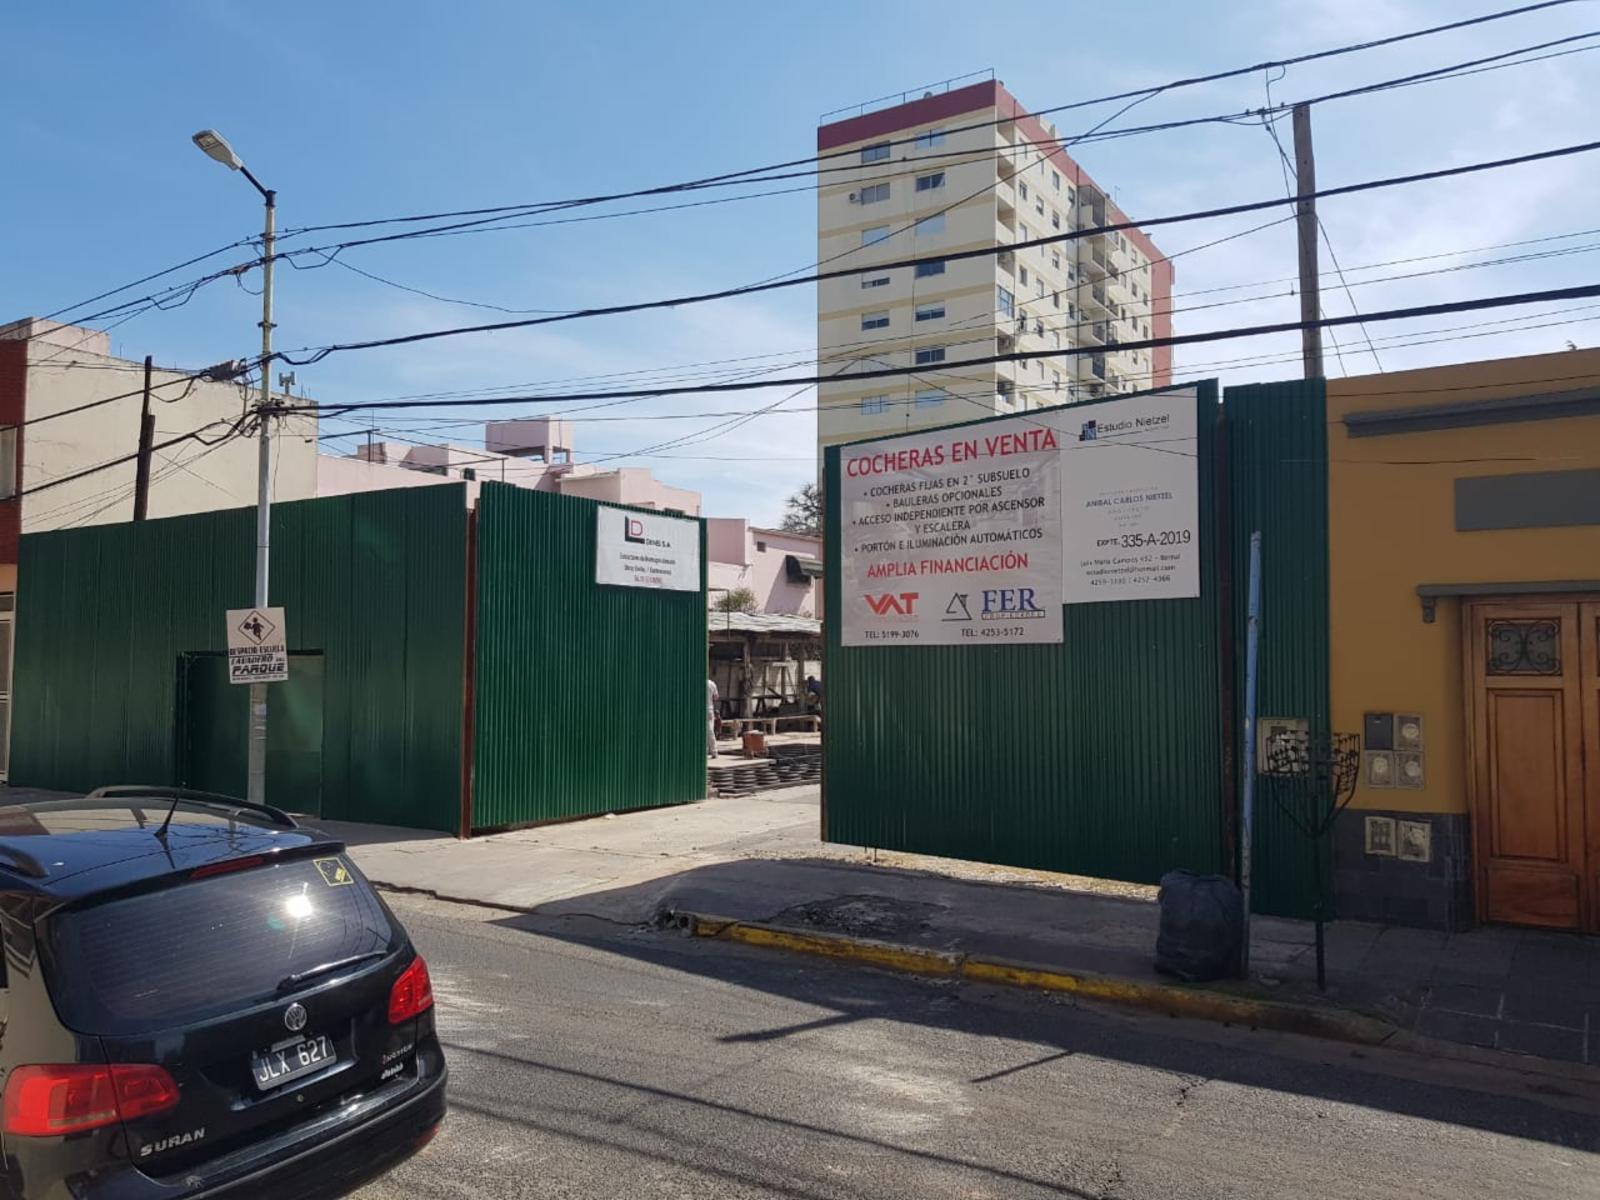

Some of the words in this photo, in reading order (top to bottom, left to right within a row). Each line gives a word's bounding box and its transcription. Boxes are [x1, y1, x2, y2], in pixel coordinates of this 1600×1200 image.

[1097, 420, 1132, 433] Estudio
[1136, 413, 1170, 427] Nietzel
[847, 445, 945, 477] COCHERAS
[952, 440, 977, 463] EN
[986, 428, 1057, 457] VENTA
[870, 482, 916, 497] COCHERAS
[919, 479, 945, 492] FIJAS
[947, 477, 960, 487] EN
[978, 468, 1030, 483] SUBSUELO
[893, 494, 939, 508] BAULERAS
[942, 486, 1002, 502] OPCIONALES
[1114, 495, 1144, 505] CARLOS
[858, 512, 891, 526] ACCESO
[894, 506, 965, 522] INDEPENDIENTE
[968, 503, 989, 513] POR
[991, 497, 1045, 511] ASCENSOR
[915, 524, 921, 533] Y
[924, 520, 971, 533] ESCALERA
[899, 540, 904, 549] E
[1121, 529, 1191, 548] 335-A-2019
[867, 559, 917, 578] AMPLIA
[921, 550, 1028, 574] FINANCIACIÓN
[864, 592, 919, 615] VAT
[982, 587, 1038, 612] FER
[882, 630, 919, 639] 5199-3076
[981, 627, 1024, 637] 4253-5172
[232, 663, 285, 674] PARQUE
[259, 1052, 292, 1083] JLX
[298, 1036, 328, 1066] 627
[140, 1127, 206, 1157] SURAN
